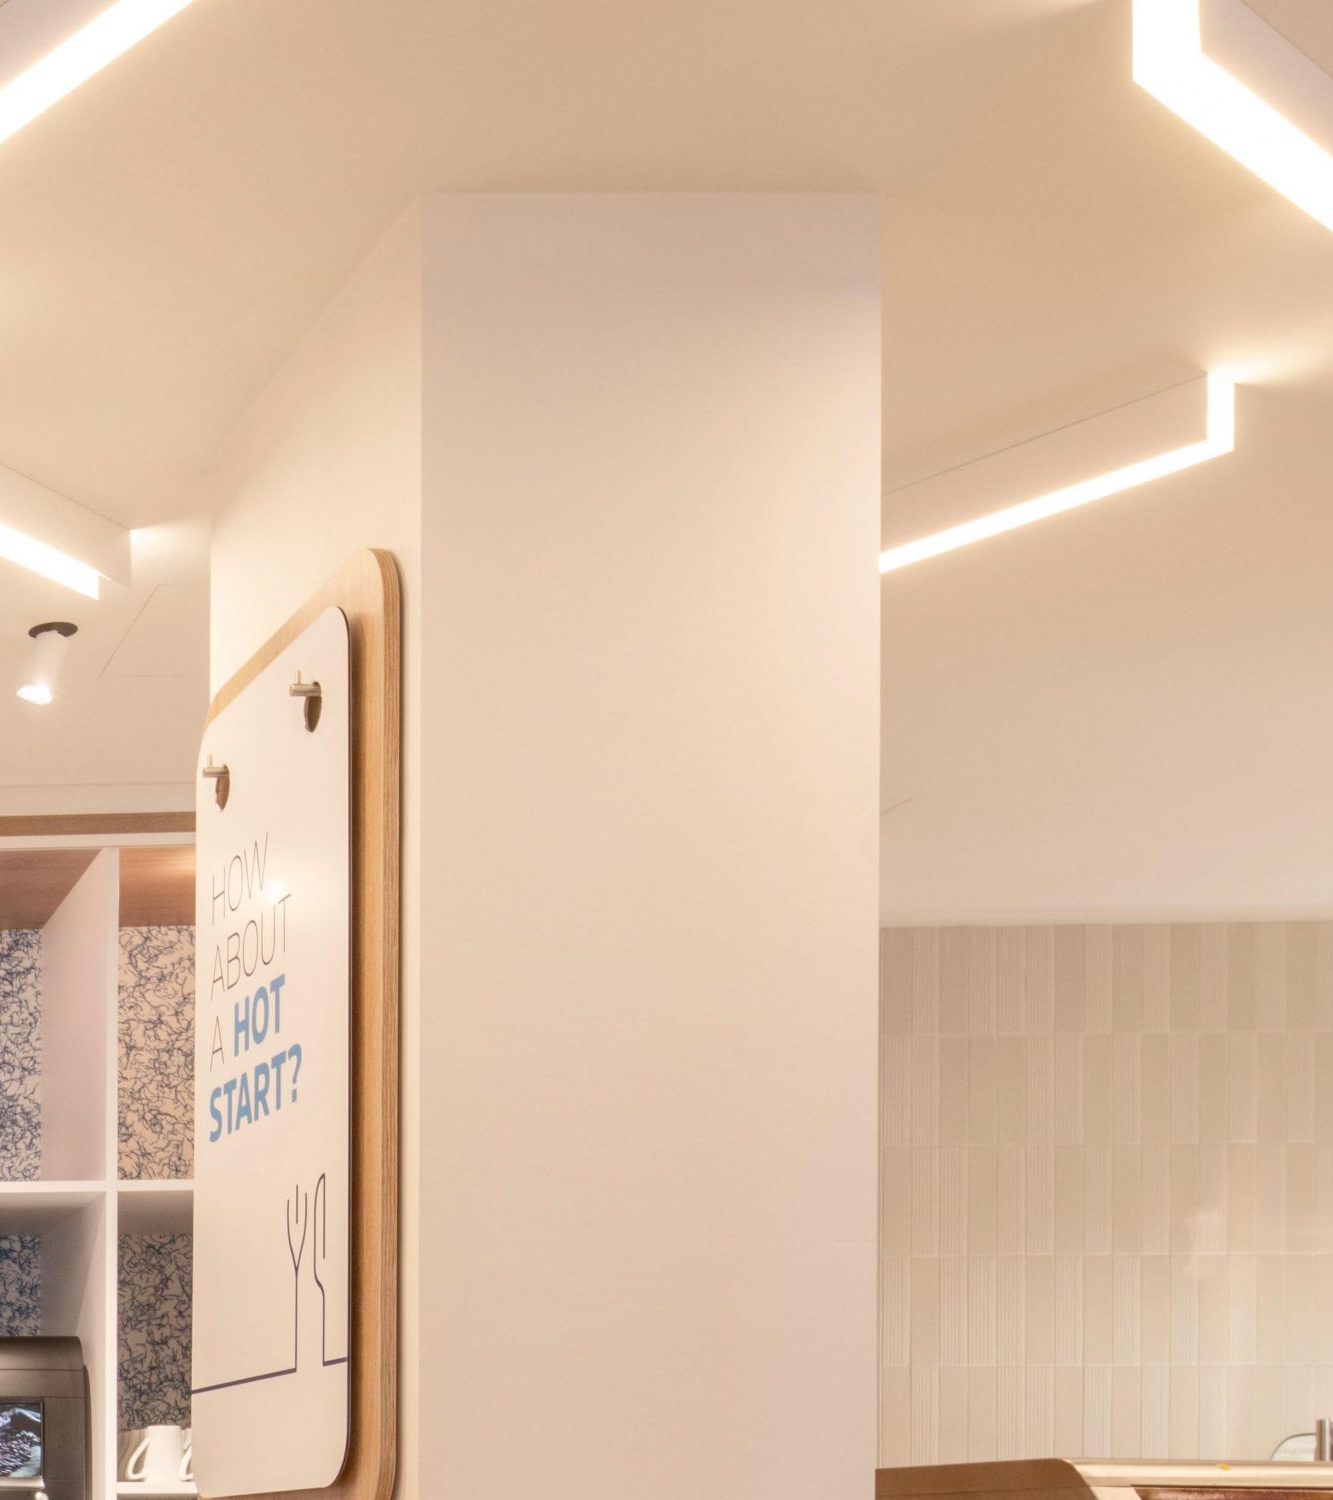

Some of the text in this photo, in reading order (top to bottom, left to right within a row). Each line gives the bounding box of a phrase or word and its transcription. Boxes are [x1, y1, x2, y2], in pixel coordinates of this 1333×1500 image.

[212, 831, 269, 927] HOW
[210, 893, 291, 1001] ABOUT
[209, 973, 285, 1072] A HOT
[209, 1043, 302, 1142] START?
